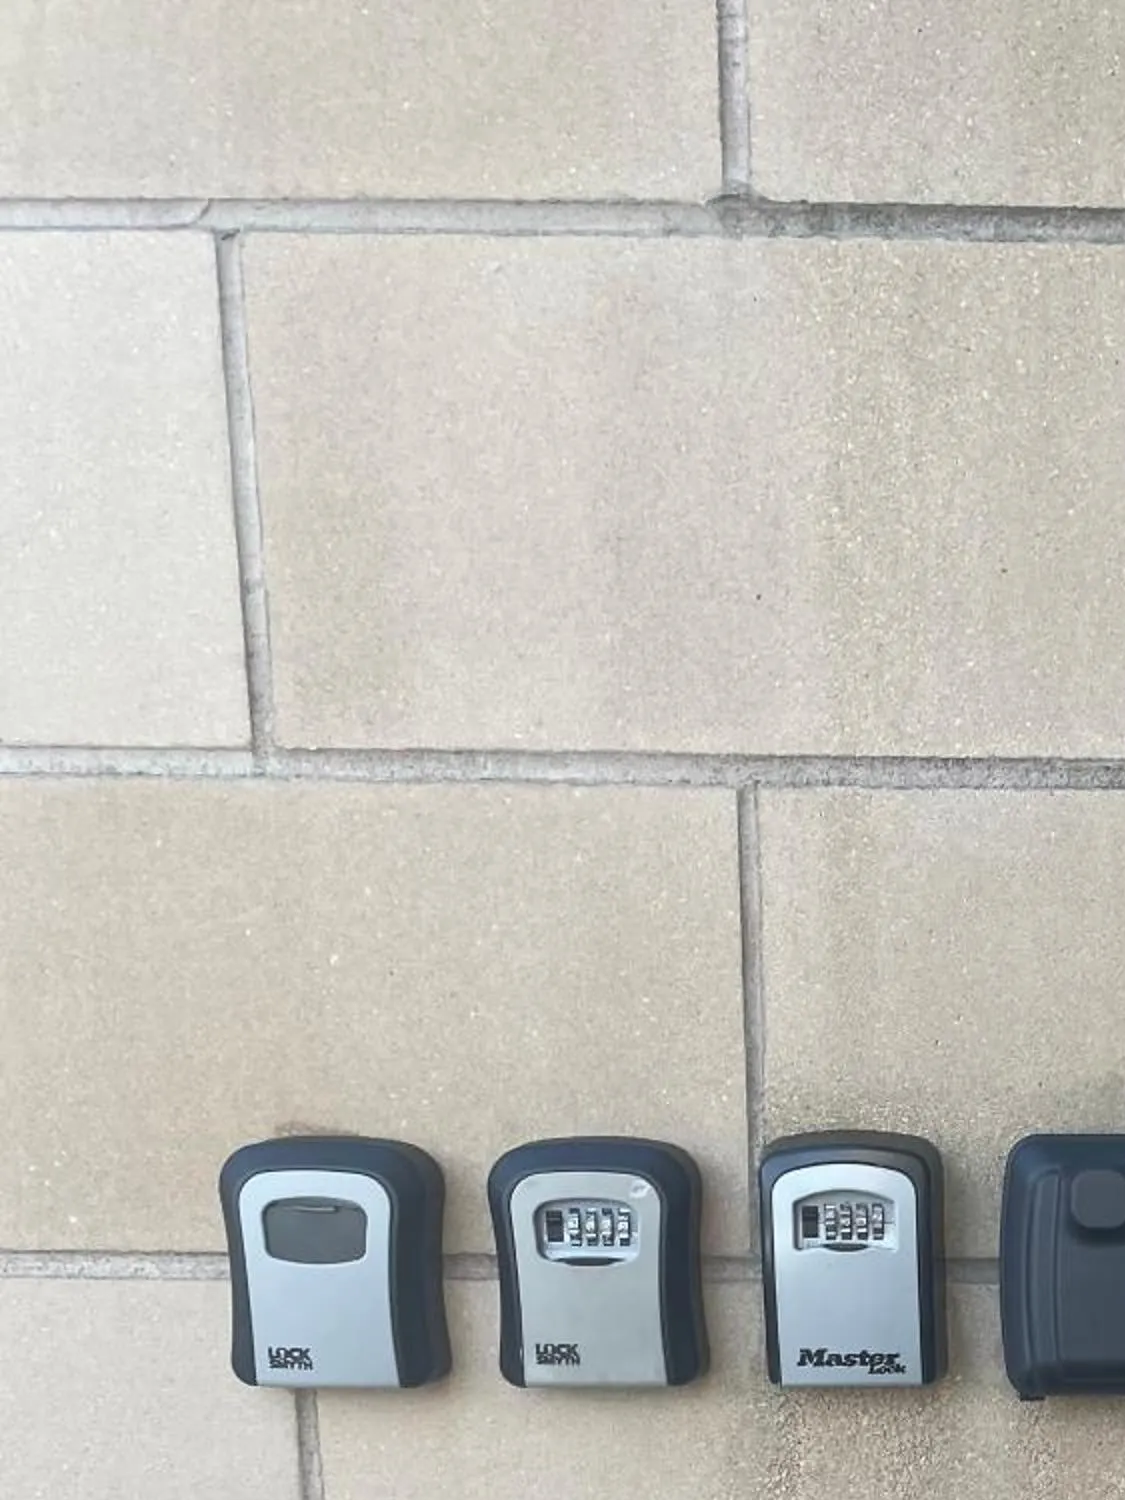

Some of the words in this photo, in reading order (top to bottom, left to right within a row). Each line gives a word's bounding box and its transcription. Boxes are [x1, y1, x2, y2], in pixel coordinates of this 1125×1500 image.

[267, 1346, 311, 1359] LOCK
[535, 1343, 580, 1355] LOCK
[797, 1347, 900, 1367] Master
[867, 1363, 906, 1375] Lock
